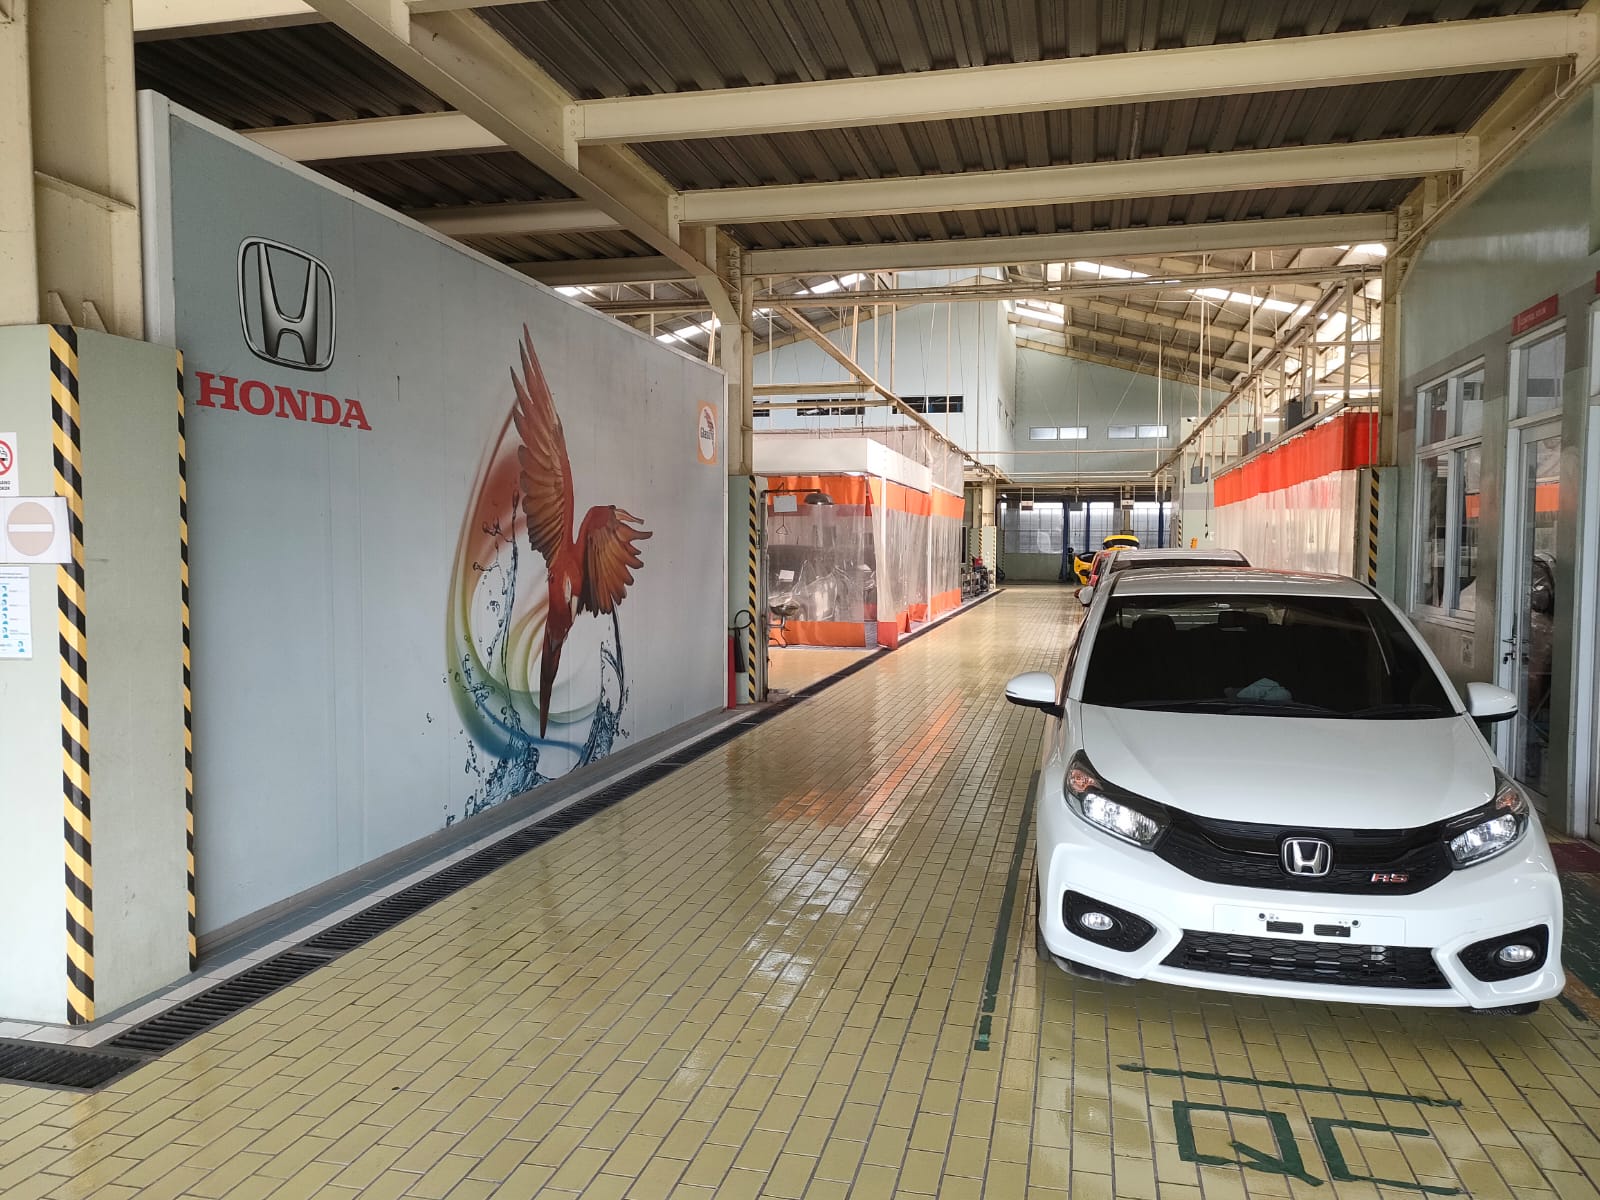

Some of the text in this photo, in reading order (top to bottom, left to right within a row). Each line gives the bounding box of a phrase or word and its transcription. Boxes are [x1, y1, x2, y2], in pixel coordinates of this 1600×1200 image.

[195, 371, 373, 431] HONDA
[1371, 873, 1408, 883] RS
[1172, 1101, 1462, 1195] QC
